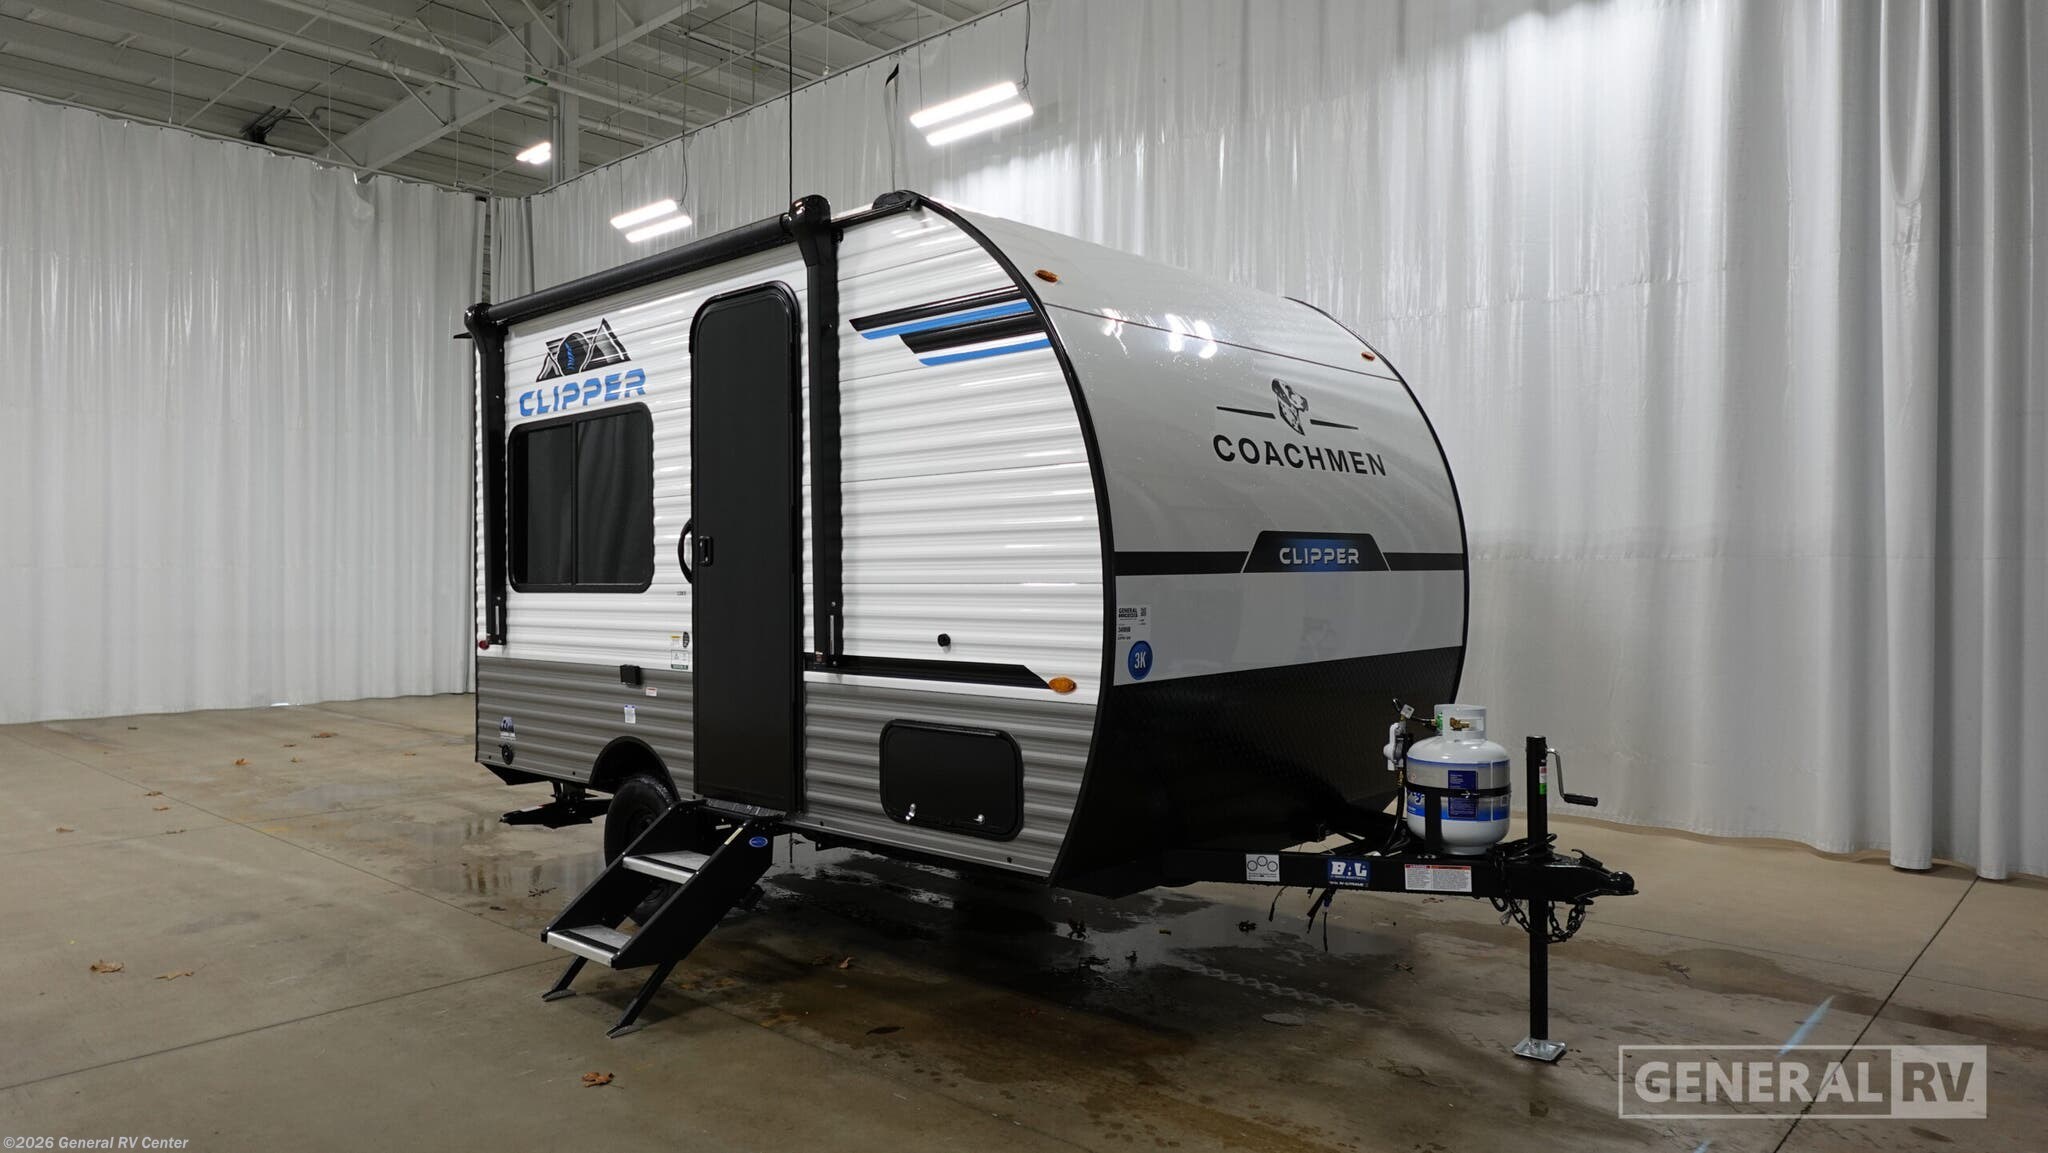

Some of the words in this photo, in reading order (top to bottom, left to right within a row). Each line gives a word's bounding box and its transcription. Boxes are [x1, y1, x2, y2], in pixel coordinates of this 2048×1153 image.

[519, 368, 646, 417] CLIPPER
[1213, 434, 1387, 476] COACHMEN
[1279, 547, 1360, 565] CLIPPER
[1134, 652, 1146, 669] 3K
[1331, 861, 1367, 877] BAL
